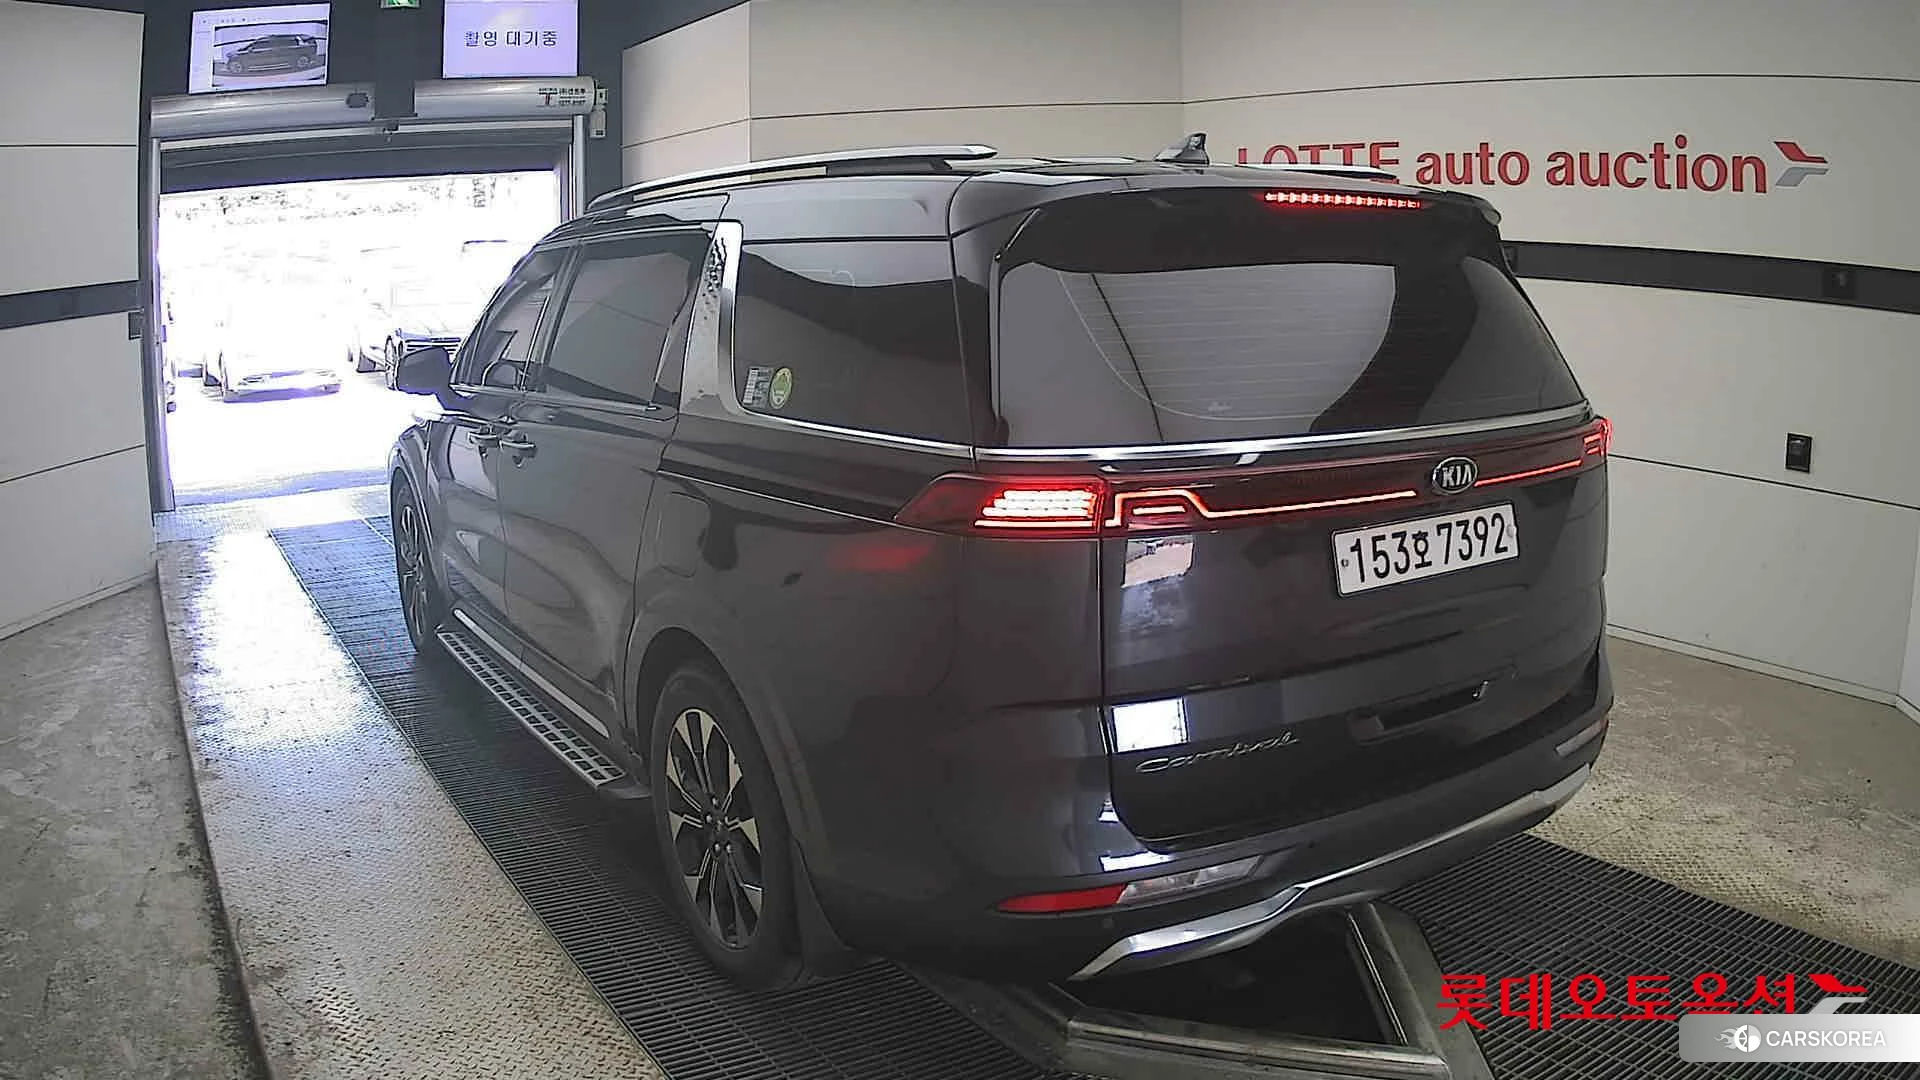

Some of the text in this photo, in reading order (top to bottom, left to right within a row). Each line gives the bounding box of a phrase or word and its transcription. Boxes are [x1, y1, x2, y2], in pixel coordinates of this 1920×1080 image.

[506, 30, 558, 47] 대기중
[1415, 143, 1529, 186] auto
[1546, 134, 1767, 194] auction
[1440, 464, 1473, 488] KIA
[1436, 512, 1508, 566] 7392
